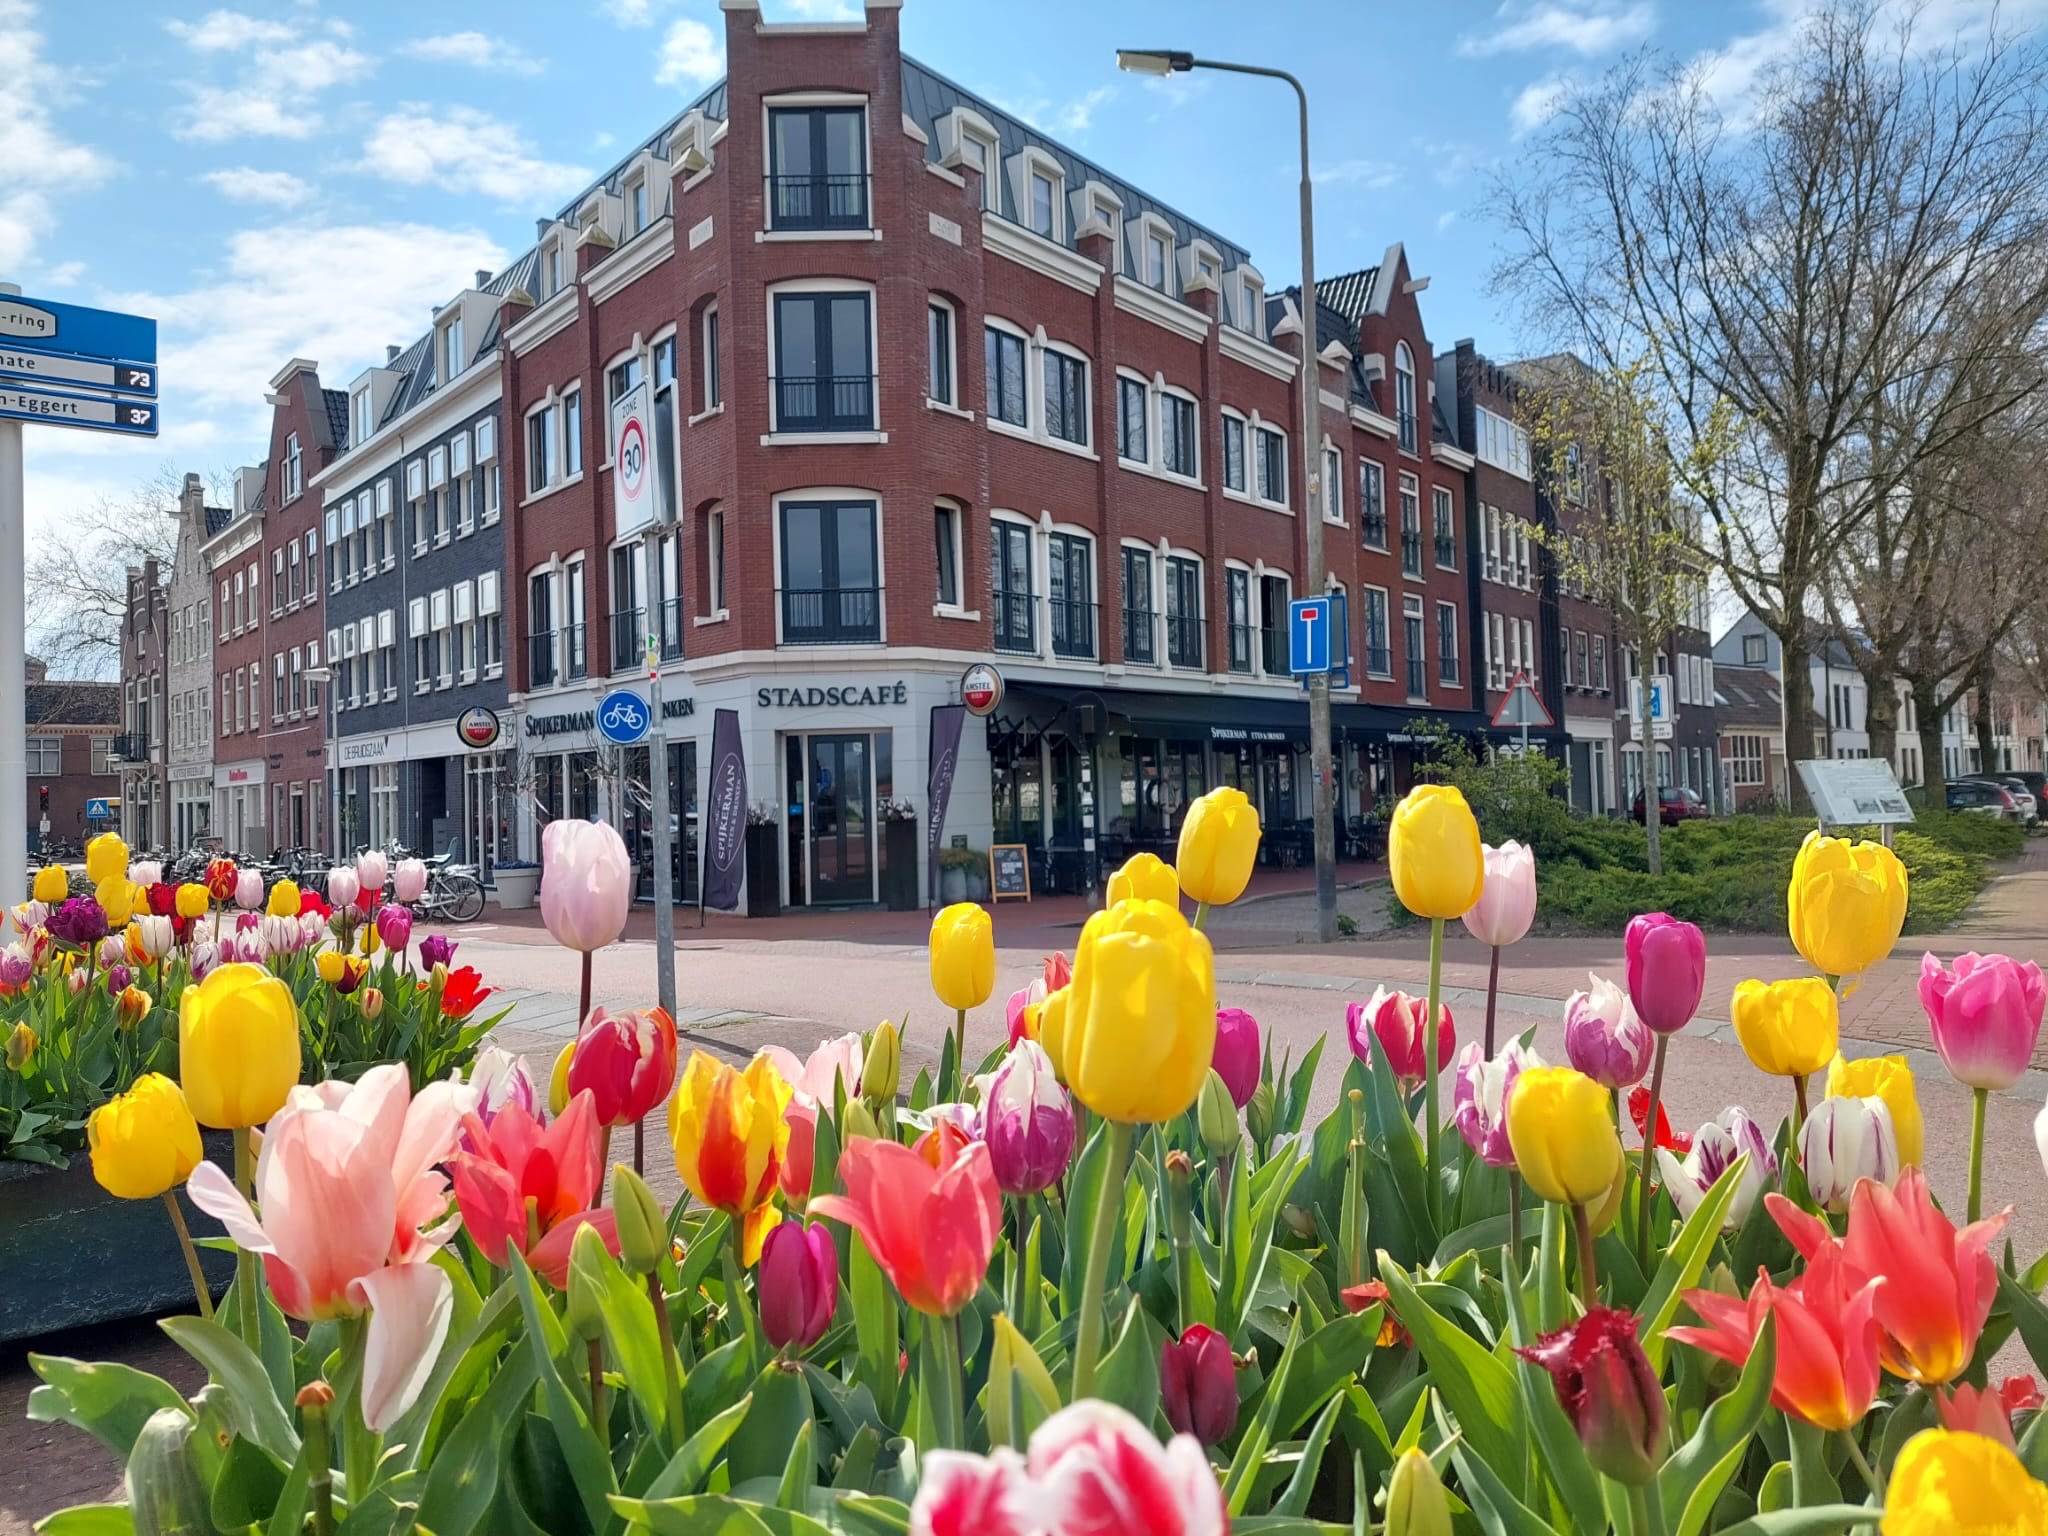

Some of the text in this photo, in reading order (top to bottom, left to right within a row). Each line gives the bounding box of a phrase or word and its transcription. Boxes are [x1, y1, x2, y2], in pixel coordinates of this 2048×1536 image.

[129, 371, 150, 387] 73
[130, 408, 150, 424] 37
[622, 397, 637, 418] ZONE
[624, 443, 641, 479] 30
[757, 680, 908, 708] STADSCAFÉ
[965, 682, 991, 690] AMSTEL
[718, 764, 735, 860] SPIJKERMAN
[727, 826, 735, 847] ETEN
